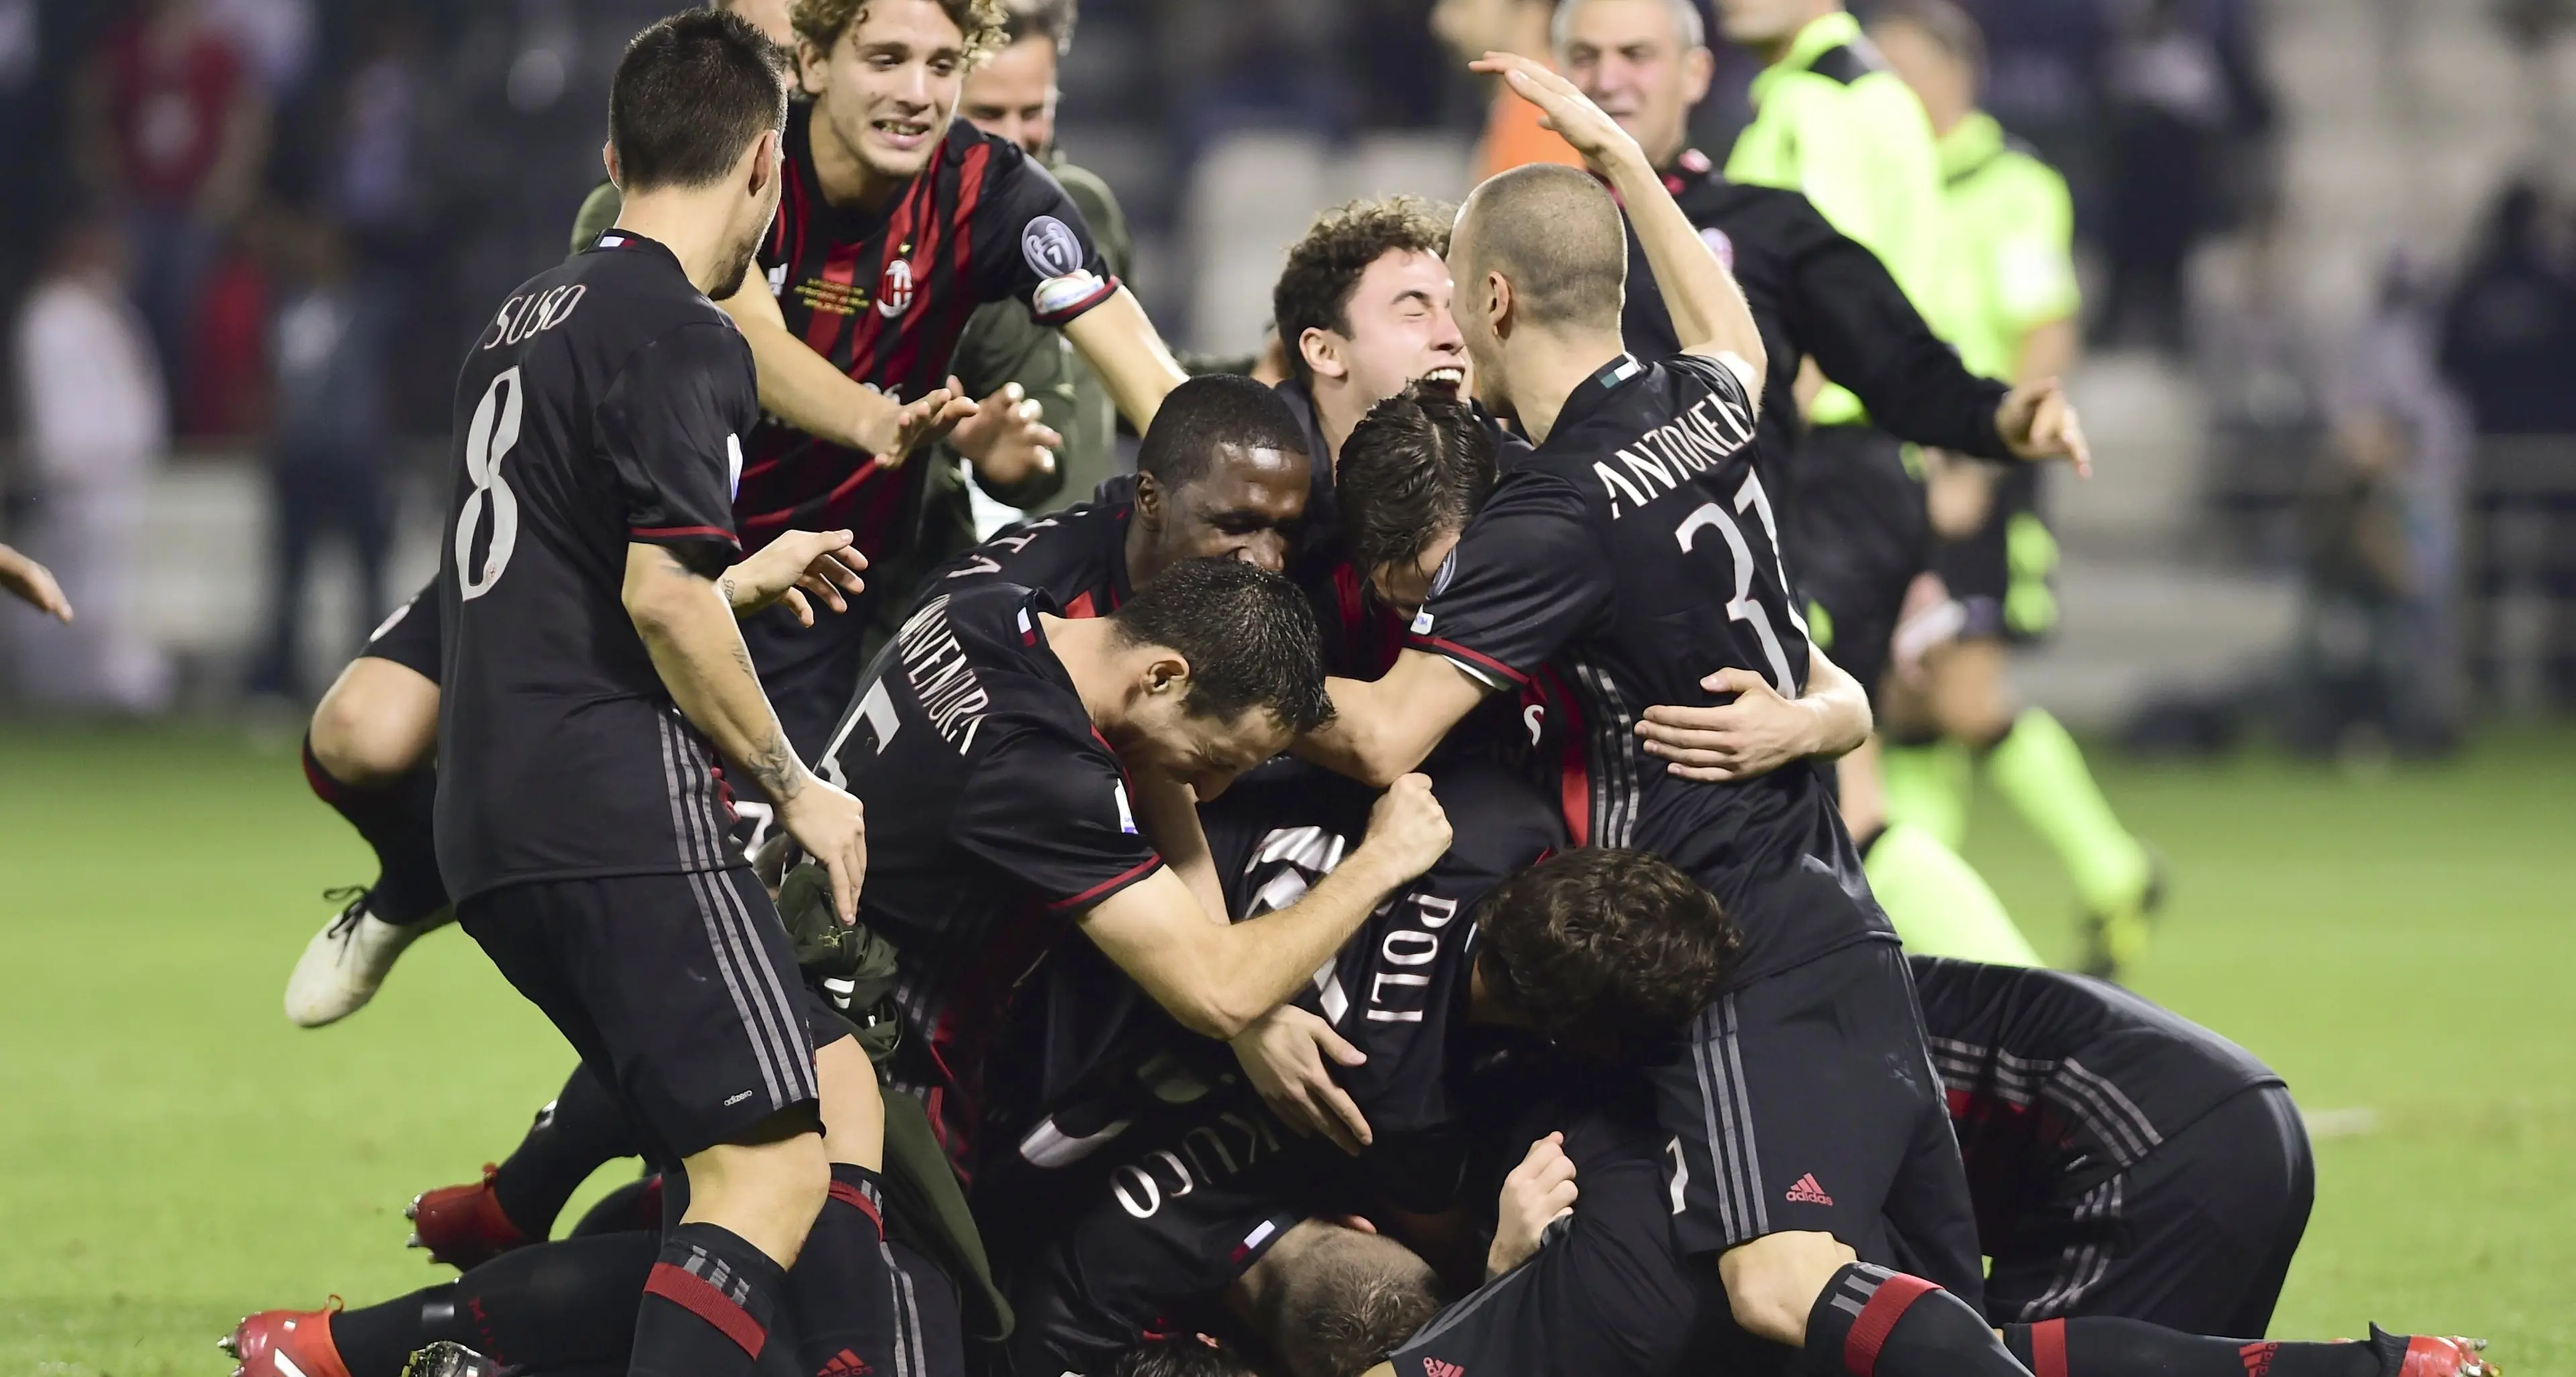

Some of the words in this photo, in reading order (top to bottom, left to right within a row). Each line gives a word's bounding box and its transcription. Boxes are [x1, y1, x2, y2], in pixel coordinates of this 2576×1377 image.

[483, 284, 588, 350] SUSO
[455, 366, 523, 602] 8
[1593, 394, 1756, 520] ANTONEL
[1367, 893, 1459, 1024] POLI
[724, 1089, 753, 1107] adizero
[1785, 1191, 1833, 1207] adidas
